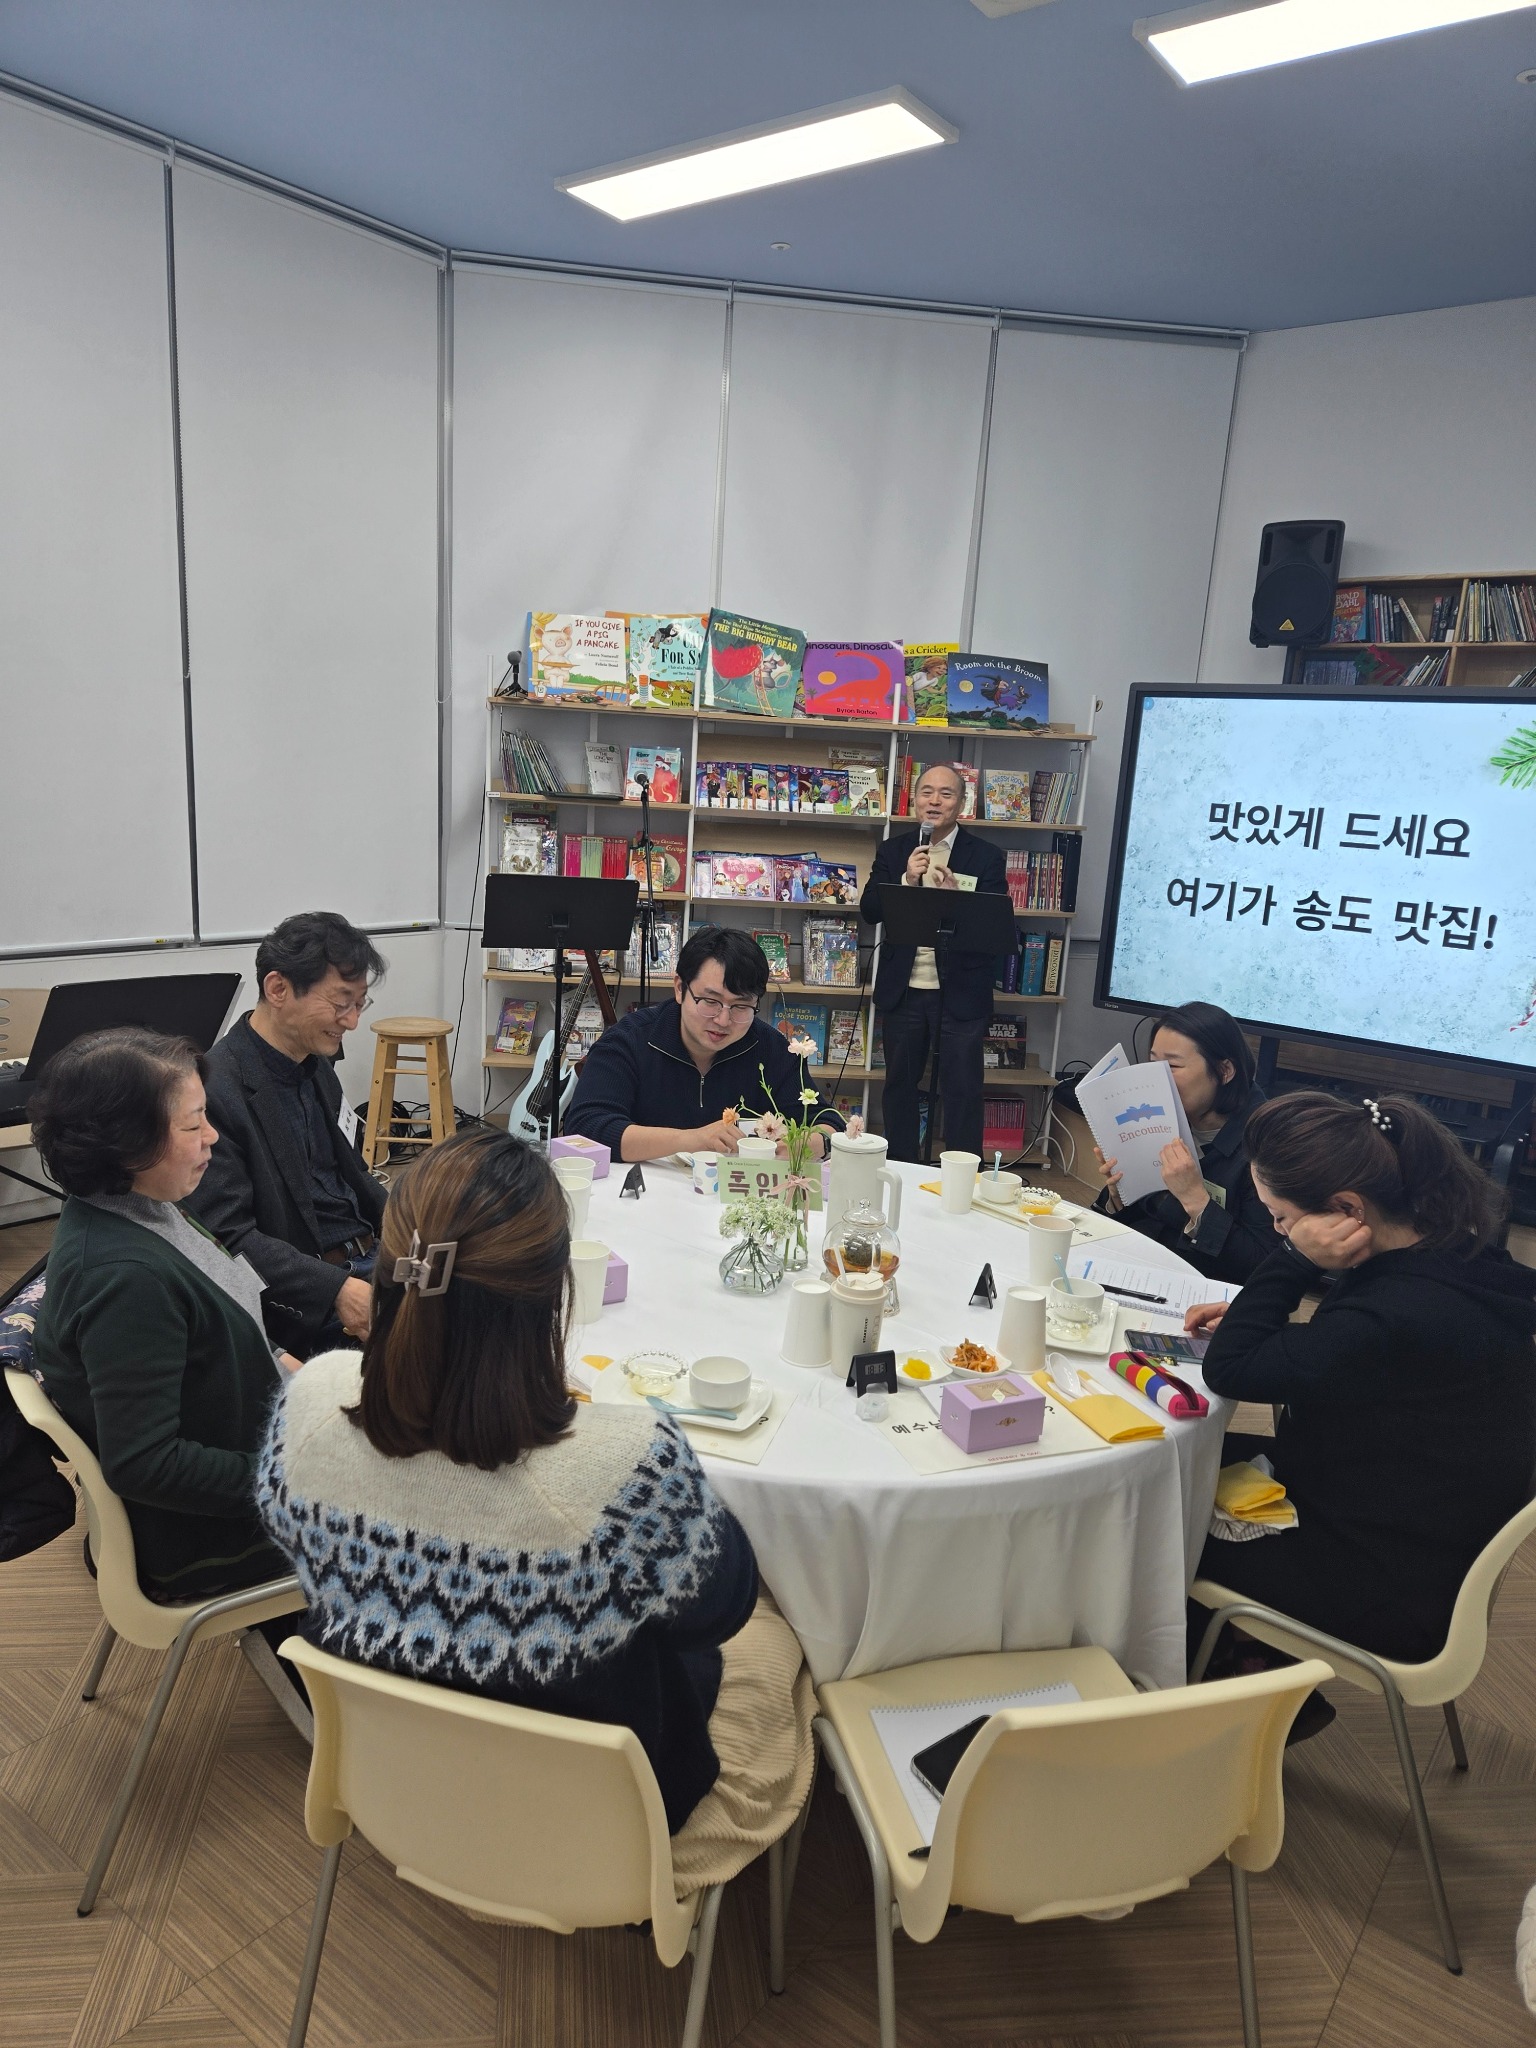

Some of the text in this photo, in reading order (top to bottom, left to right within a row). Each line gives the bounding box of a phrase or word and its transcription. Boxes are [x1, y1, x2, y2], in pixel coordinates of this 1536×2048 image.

[1336, 592, 1360, 601] ROALD
[1336, 599, 1360, 609] DAHL
[575, 619, 621, 630] IF YOU GIVE
[743, 624, 754, 632] Ripe
[748, 620, 760, 628] Little
[594, 630, 608, 638] PIG
[714, 622, 798, 652] THE BIG HUNGRY BEAR
[584, 640, 620, 649] PANCAKE
[916, 645, 947, 654] Cricket
[662, 648, 685, 664] FOR
[954, 662, 982, 670] Room
[997, 661, 1012, 670] the
[1014, 664, 1042, 682] Broom
[856, 708, 878, 716] Barton
[1208, 802, 1470, 858] 맛있게 드세요
[1167, 878, 1498, 950] 여기가 송도 맛집!
[1049, 950, 1060, 989] DINOSAURS
[774, 1012, 817, 1021] LOOSE TOOTH
[989, 1030, 1018, 1038] WARS
[1118, 1125, 1172, 1144] Encounter
